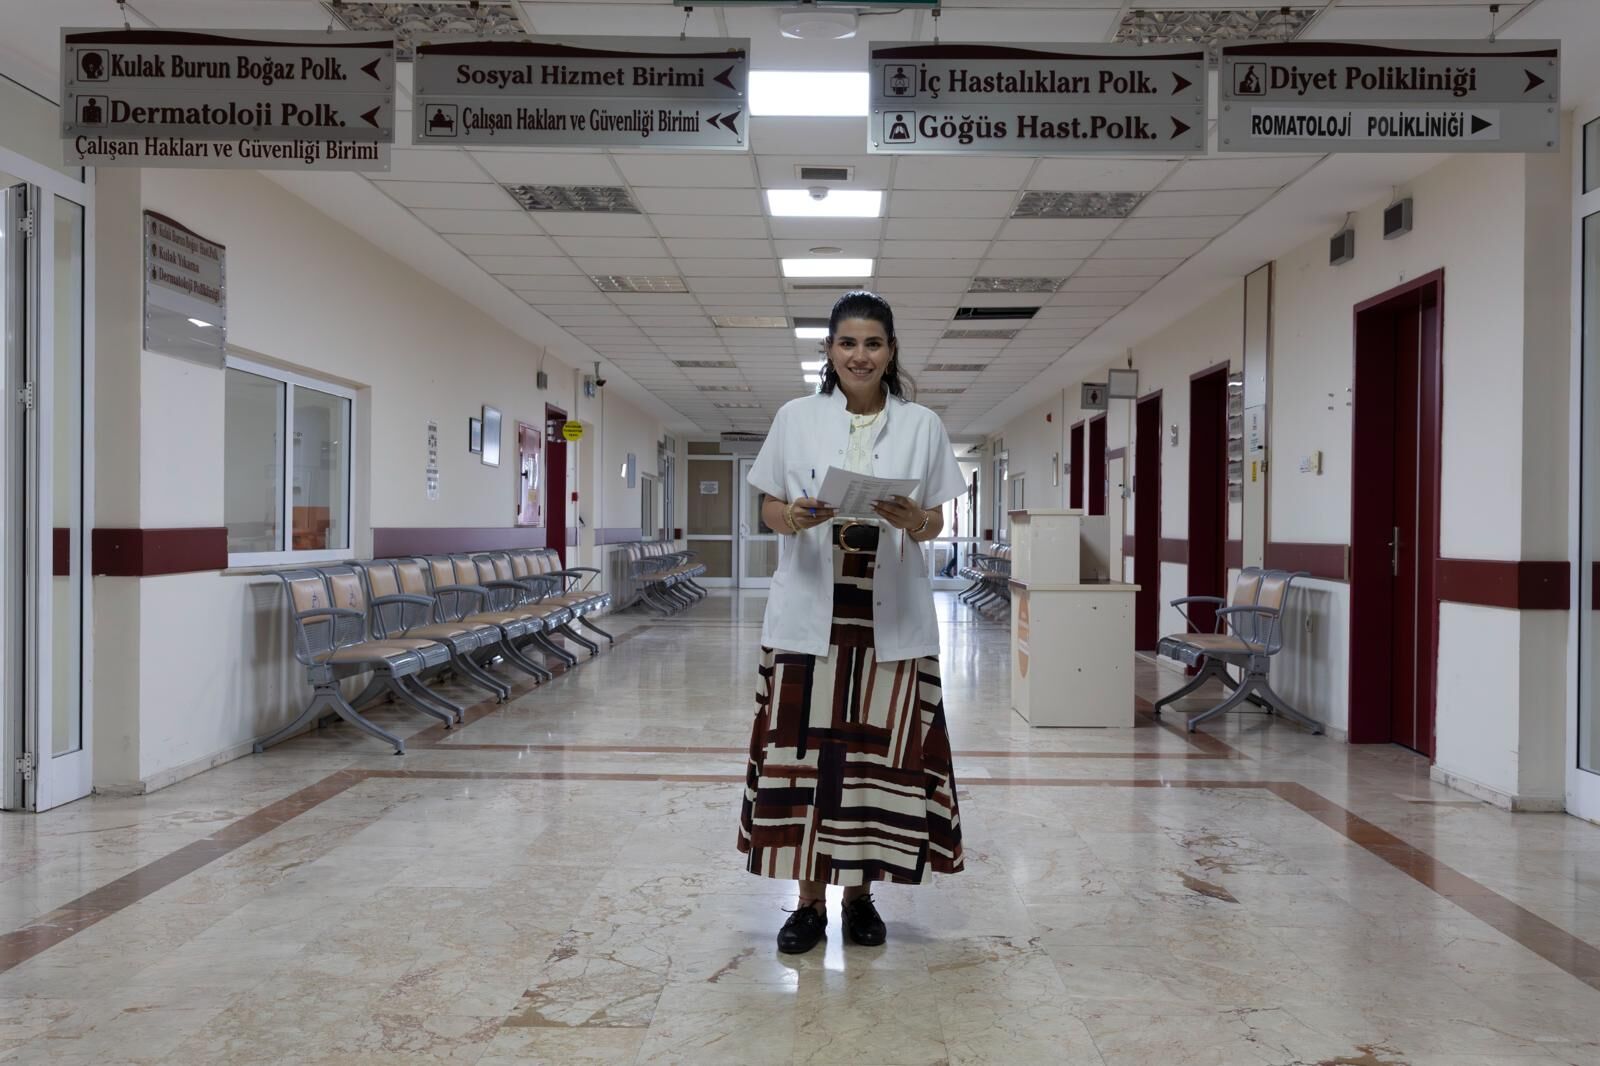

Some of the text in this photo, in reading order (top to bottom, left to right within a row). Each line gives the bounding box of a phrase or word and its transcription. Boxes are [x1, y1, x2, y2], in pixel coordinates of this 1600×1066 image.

[111, 53, 348, 86] Kulak Burun Boğaz Polk.
[456, 64, 705, 89] Sosyal Hizmet Birimi
[919, 63, 1158, 99] İç Hastalıkları Polk.
[1270, 66, 1477, 97] Diyet Polikliniği
[110, 100, 346, 131] Dermatoloji Polk.
[462, 107, 700, 137] Çalışan Hakları ve Güvenliği Birimi
[918, 115, 1158, 145] Göğüs Hast.Polk.
[1251, 111, 1464, 138] ROMATOLOJİ POLİKLİNİĞİ
[75, 135, 380, 164] Çalışan Hakları ve Güvenliği Birimi
[159, 246, 200, 273] Kulak Yıkama
[159, 267, 193, 296] Dermatoloji
